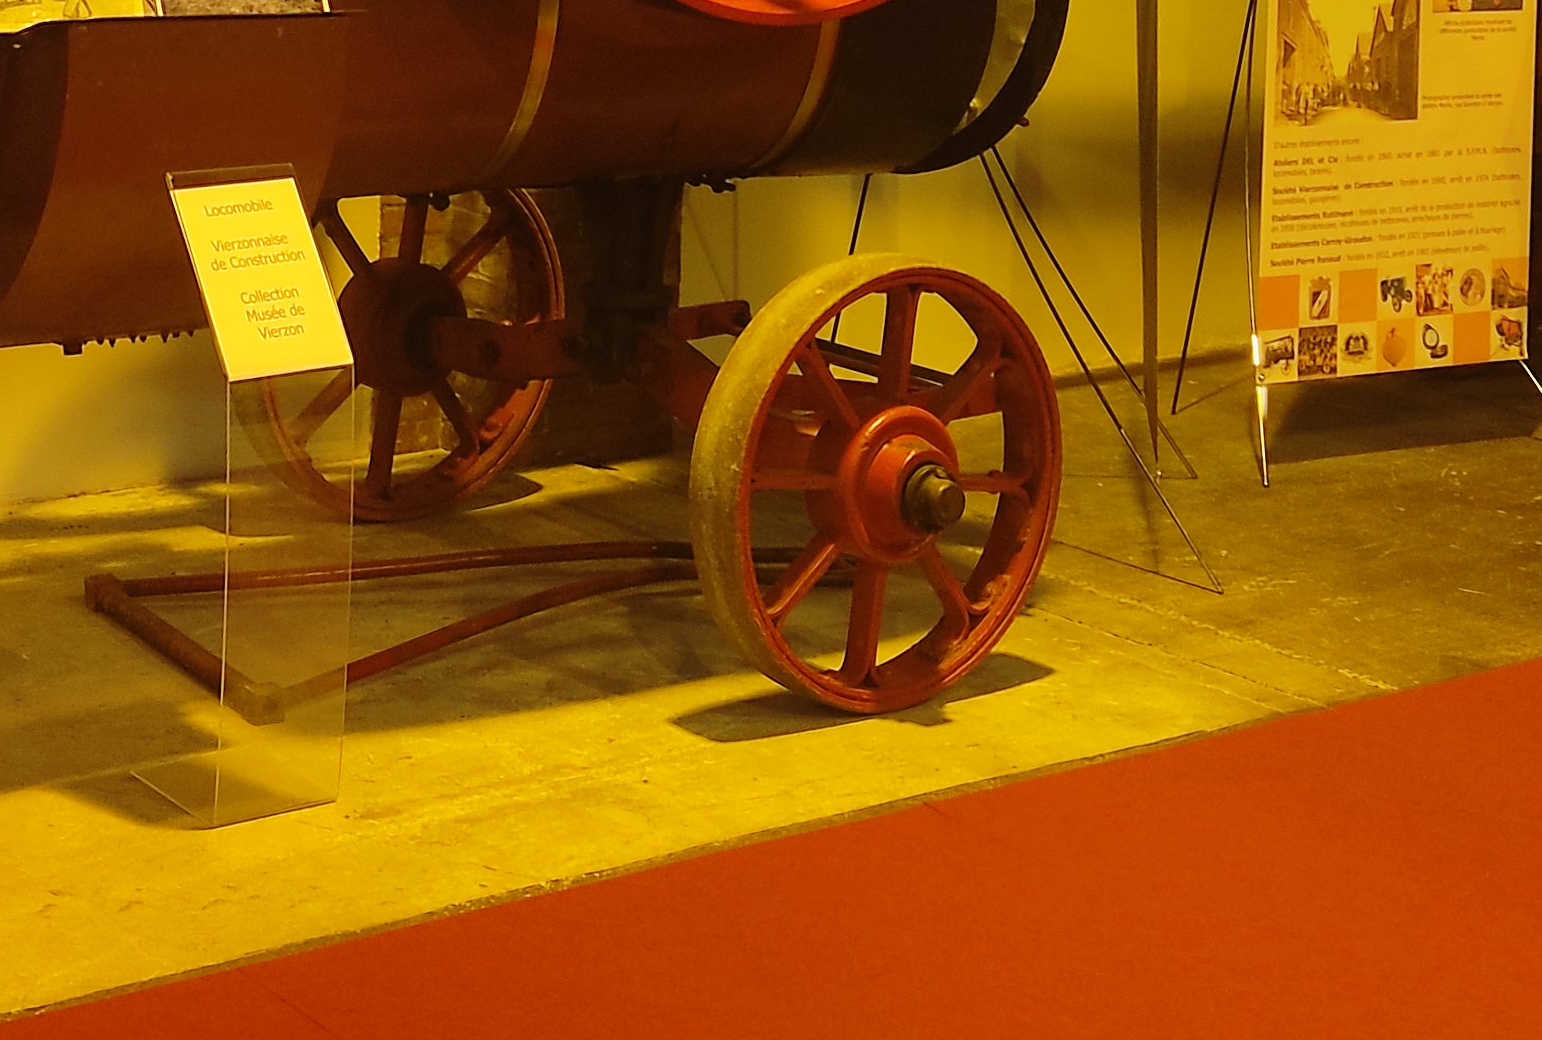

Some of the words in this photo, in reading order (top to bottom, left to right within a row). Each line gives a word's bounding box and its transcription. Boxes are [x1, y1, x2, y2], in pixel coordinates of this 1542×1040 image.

[205, 199, 273, 217] Locomobile
[212, 234, 289, 252] Vierzonnaise
[211, 258, 227, 271] de
[230, 250, 306, 268] Construction
[241, 287, 299, 304] Collection
[247, 306, 286, 322] Musée
[290, 304, 305, 316] de
[258, 324, 304, 339] Vierzon
